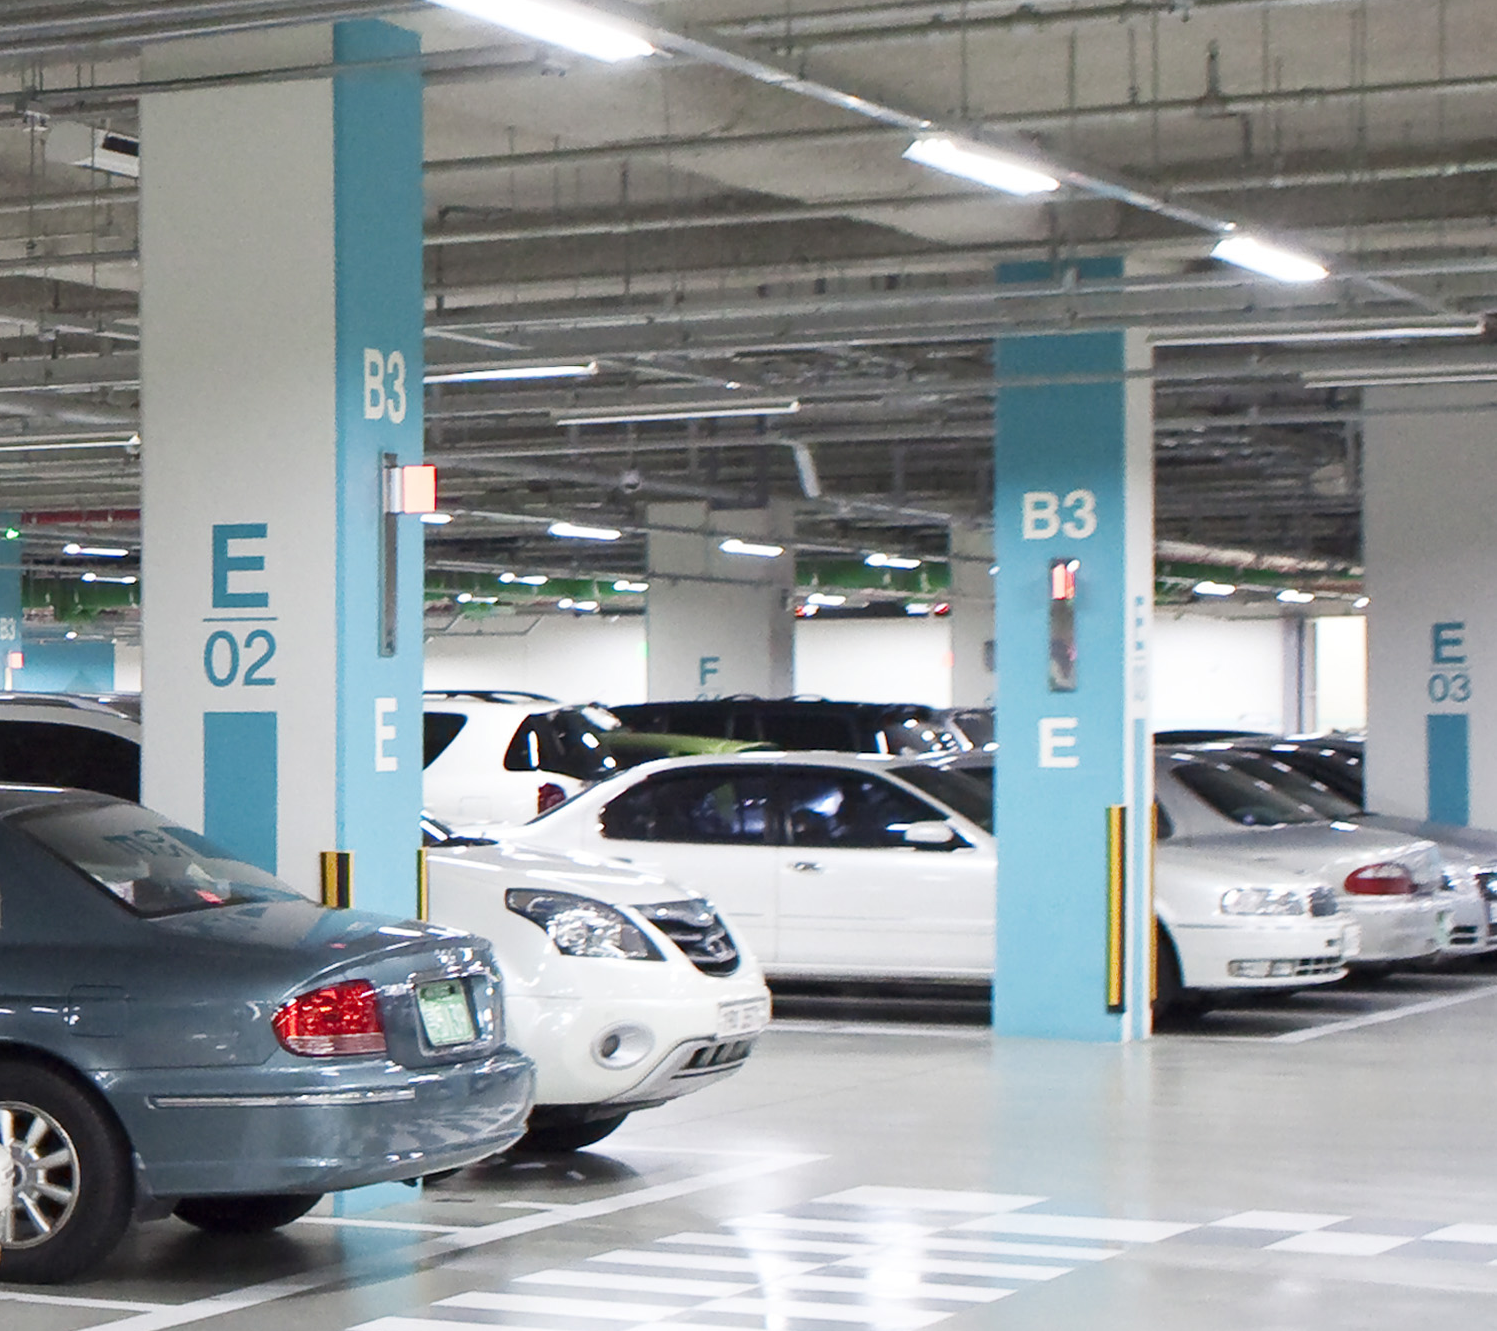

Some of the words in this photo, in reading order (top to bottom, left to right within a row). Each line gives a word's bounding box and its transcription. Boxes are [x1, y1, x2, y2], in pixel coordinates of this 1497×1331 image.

[363, 348, 407, 424] B3
[1022, 489, 1098, 540] B3
[212, 523, 269, 609] E
[204, 629, 277, 688] 02
[1432, 621, 1467, 664] E
[699, 656, 720, 687] F
[1428, 673, 1473, 704] 03
[374, 697, 398, 772] E
[1037, 717, 1080, 769] E
